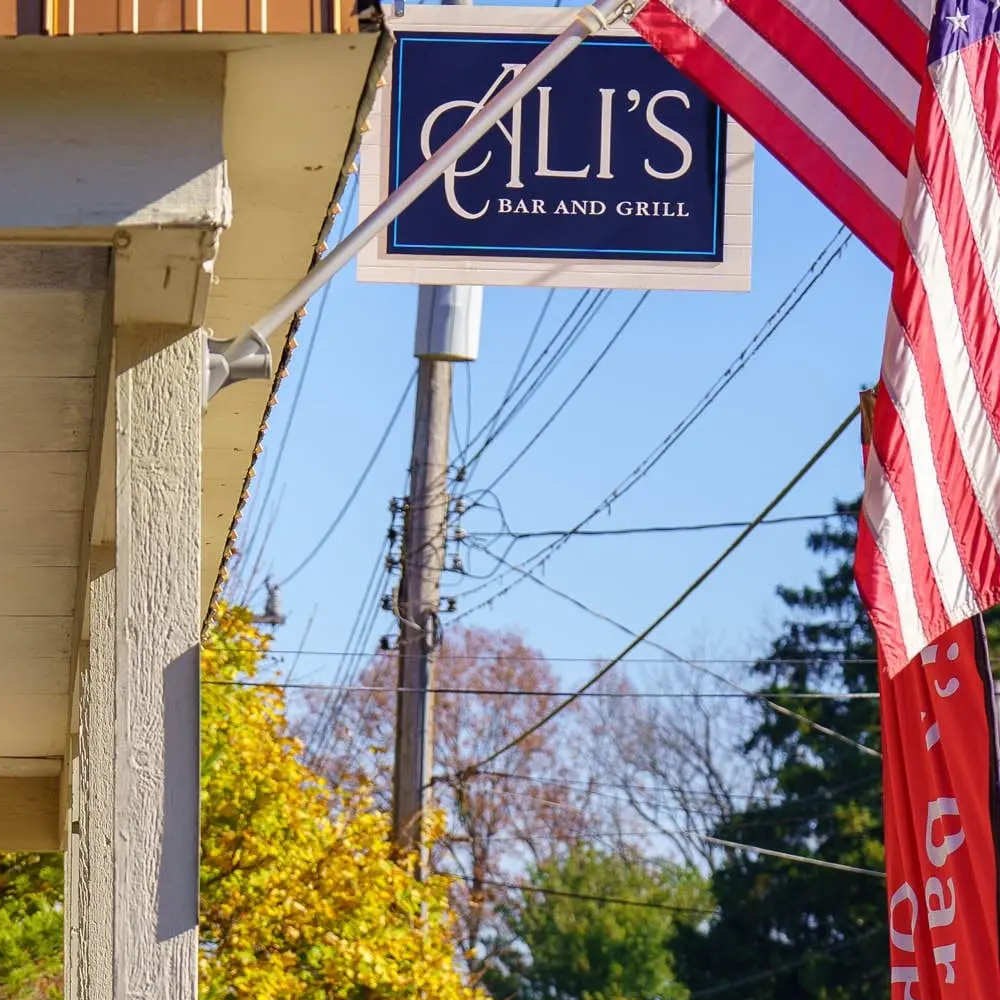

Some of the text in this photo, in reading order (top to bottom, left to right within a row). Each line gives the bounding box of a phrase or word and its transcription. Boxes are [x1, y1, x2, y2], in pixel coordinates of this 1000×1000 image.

[498, 198, 690, 217] BAR AND GRILL
[924, 796, 966, 985] Bar
